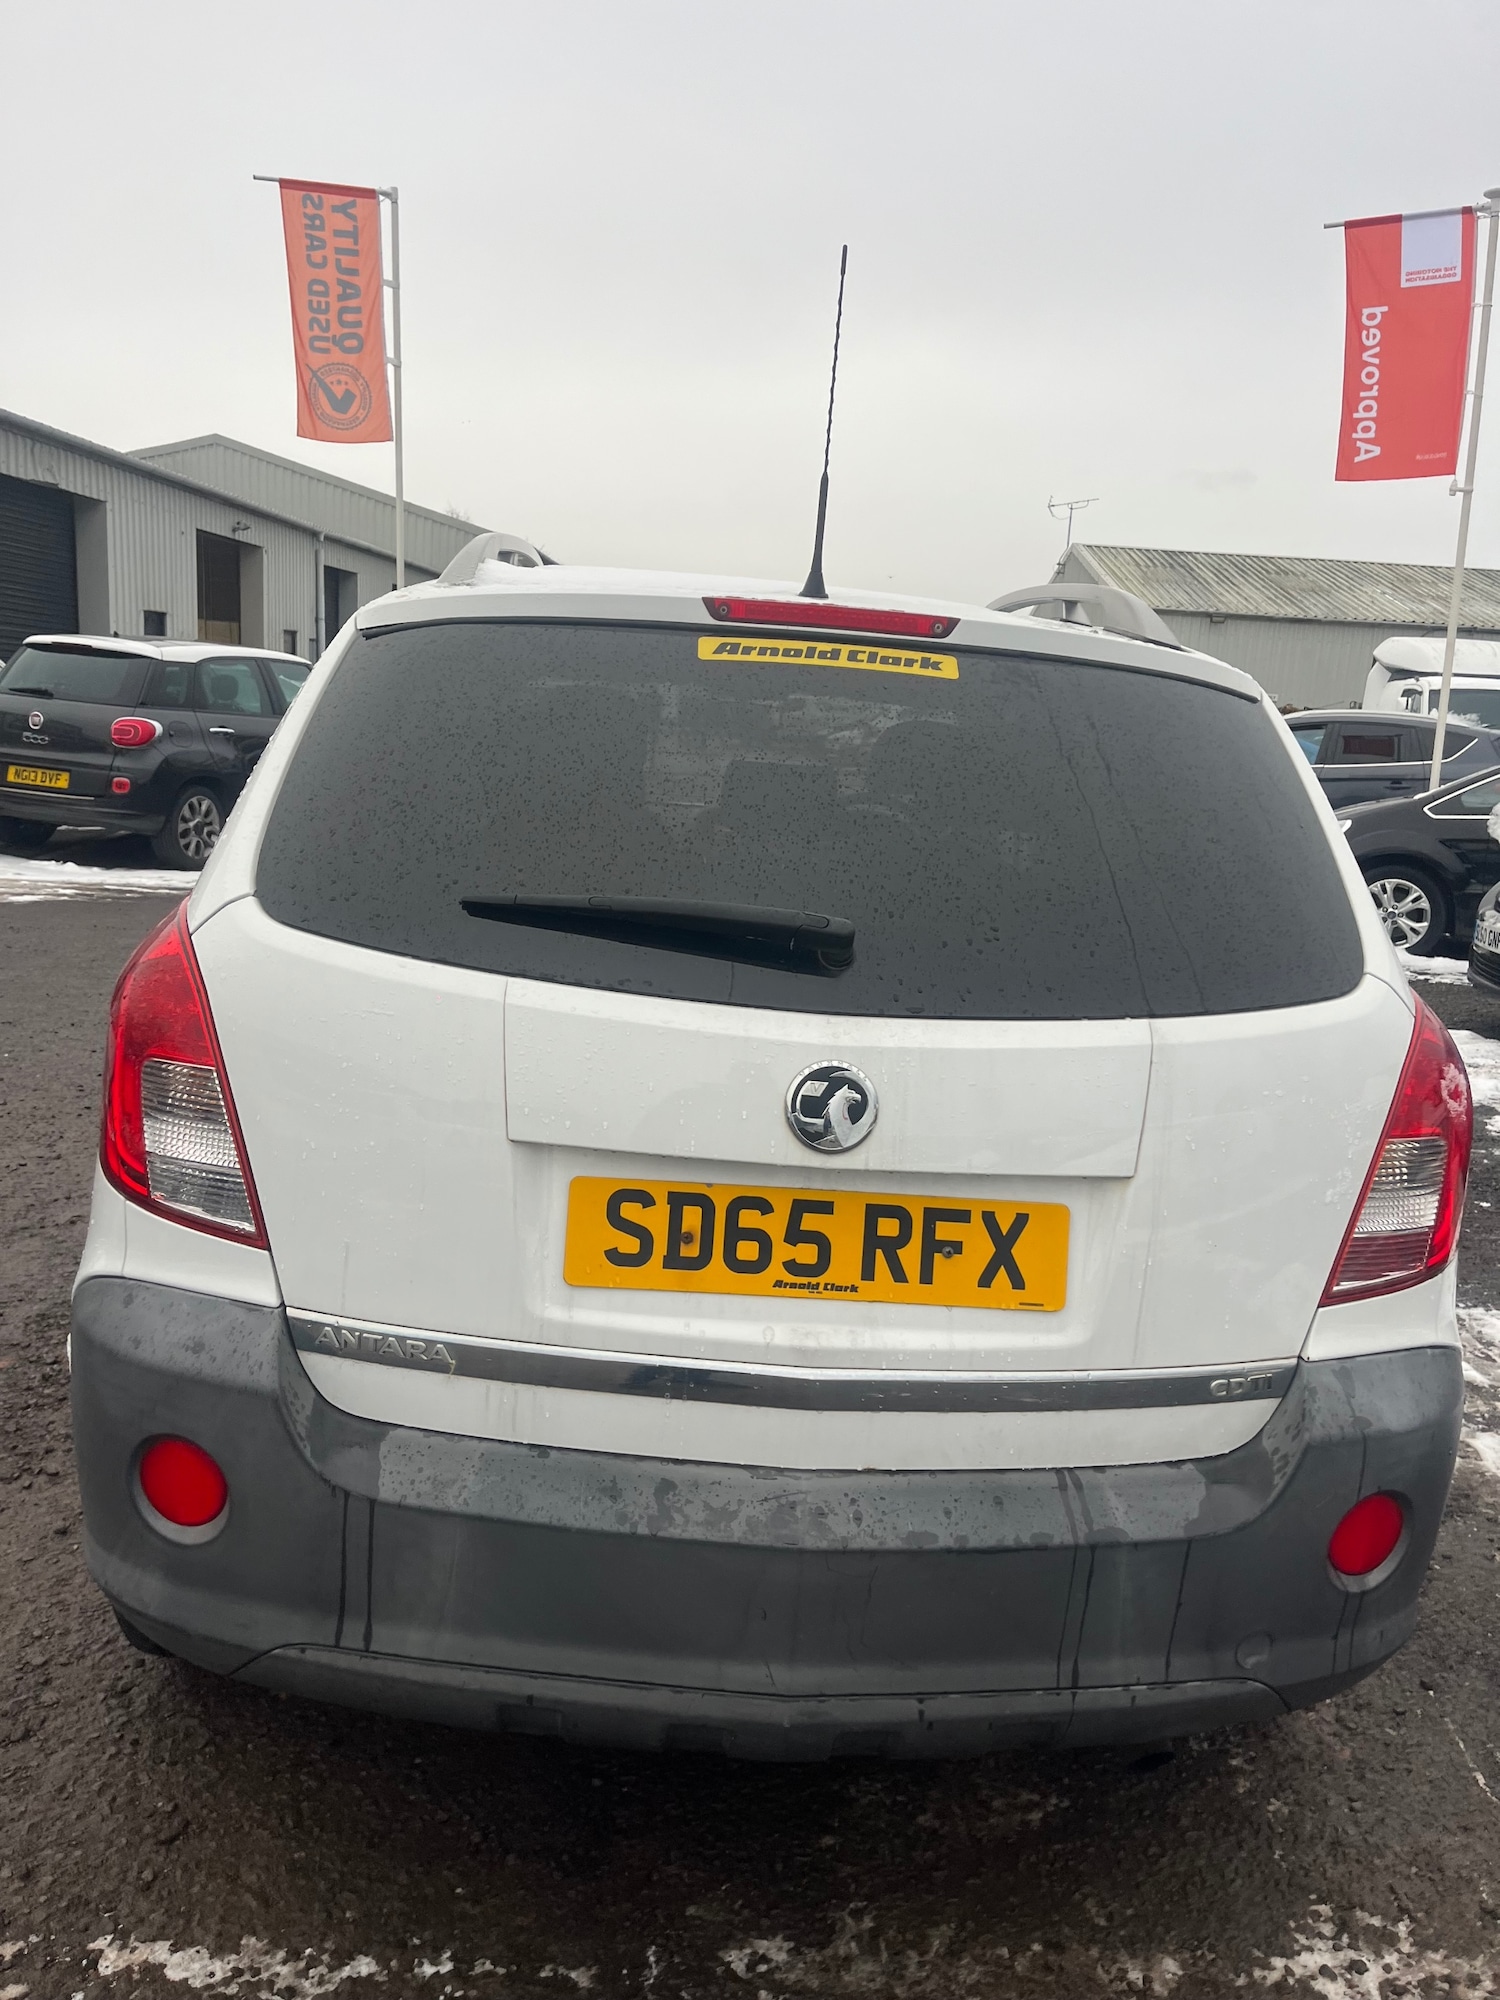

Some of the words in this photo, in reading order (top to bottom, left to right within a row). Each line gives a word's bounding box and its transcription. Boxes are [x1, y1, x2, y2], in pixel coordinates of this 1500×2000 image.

[712, 642, 842, 662] Arnold
[846, 650, 944, 671] Clark
[40, 771, 62, 785] DVF
[603, 1188, 834, 1279] SD65
[861, 1203, 1030, 1290] RFX
[772, 1280, 820, 1291] Arnold
[823, 1283, 859, 1293] Clark
[315, 1326, 454, 1364] ANTARA
